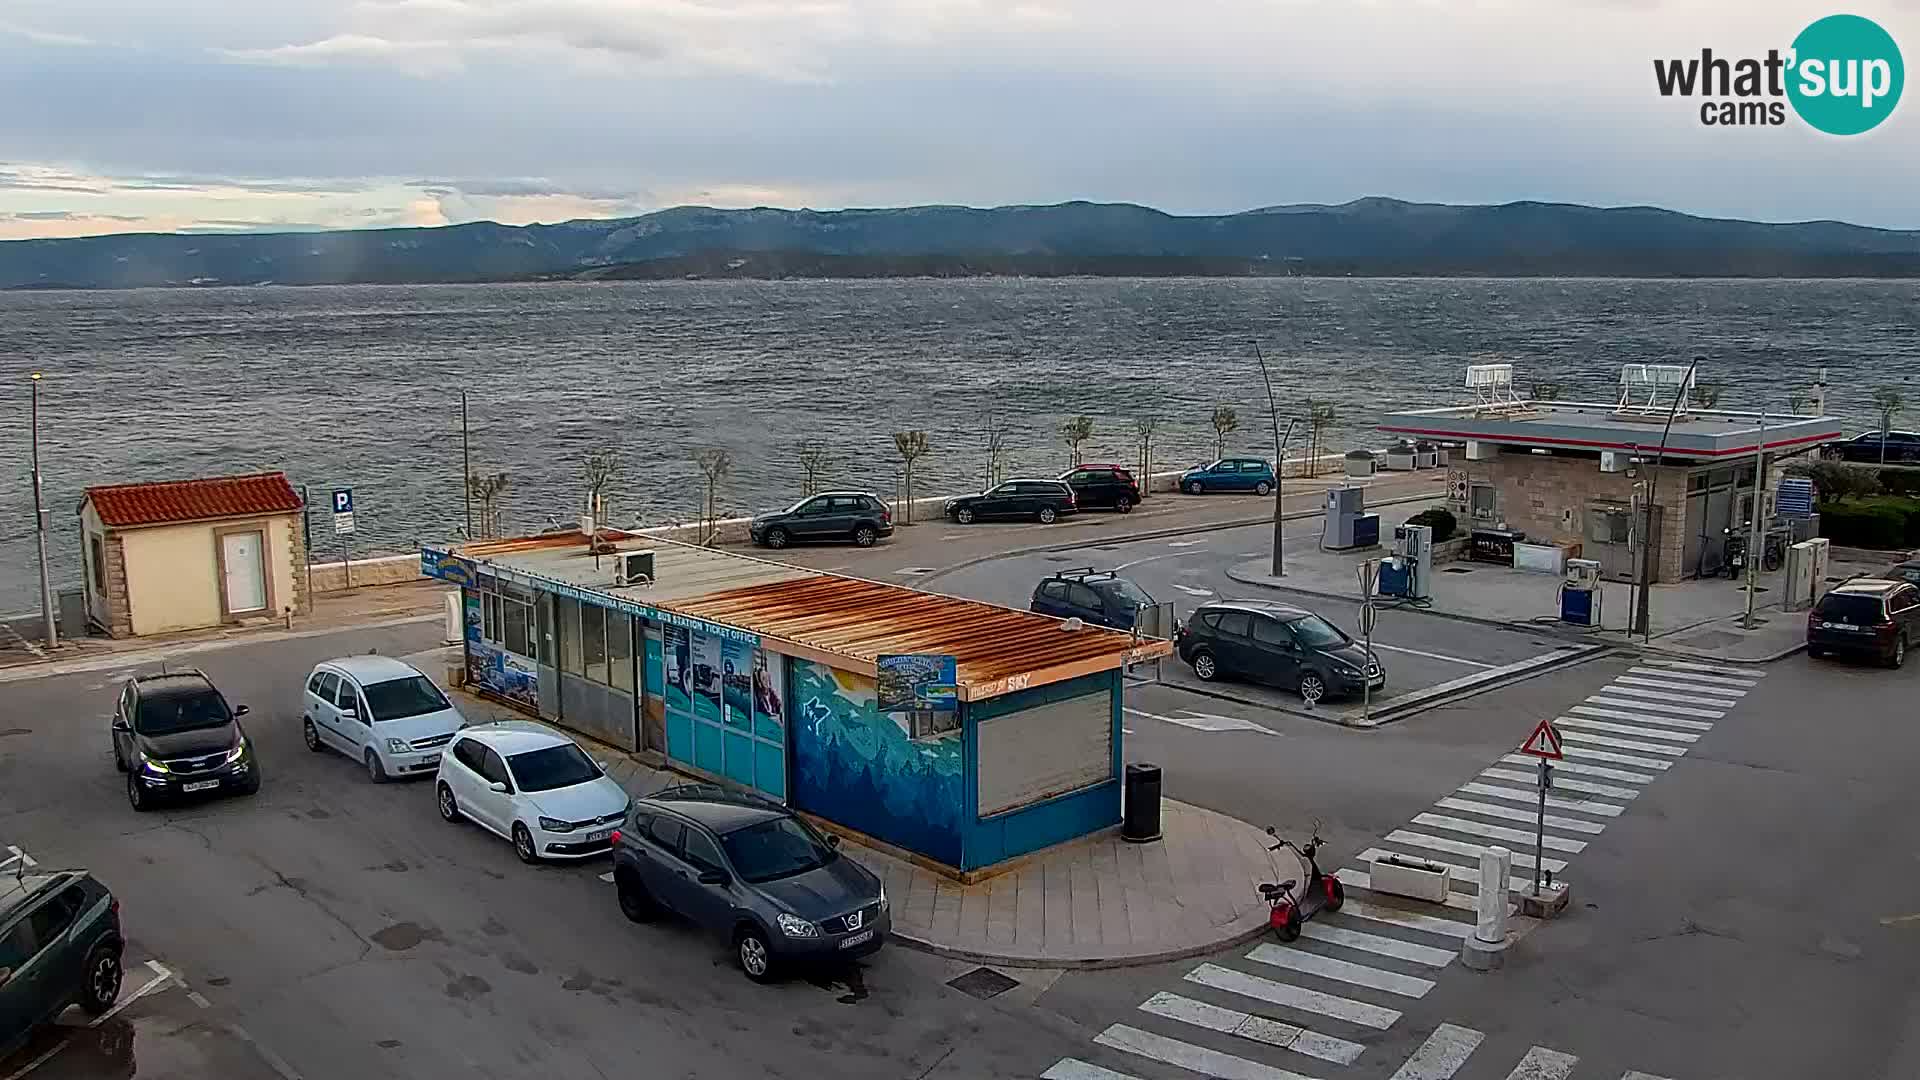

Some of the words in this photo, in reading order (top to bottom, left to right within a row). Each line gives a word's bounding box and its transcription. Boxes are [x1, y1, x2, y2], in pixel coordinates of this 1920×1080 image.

[336, 492, 349, 510] P
[618, 600, 648, 617] POSTAJA
[657, 609, 672, 623] BUS
[673, 614, 703, 631] STATION
[704, 622, 731, 637] TICKET
[730, 629, 758, 645] OFFICE
